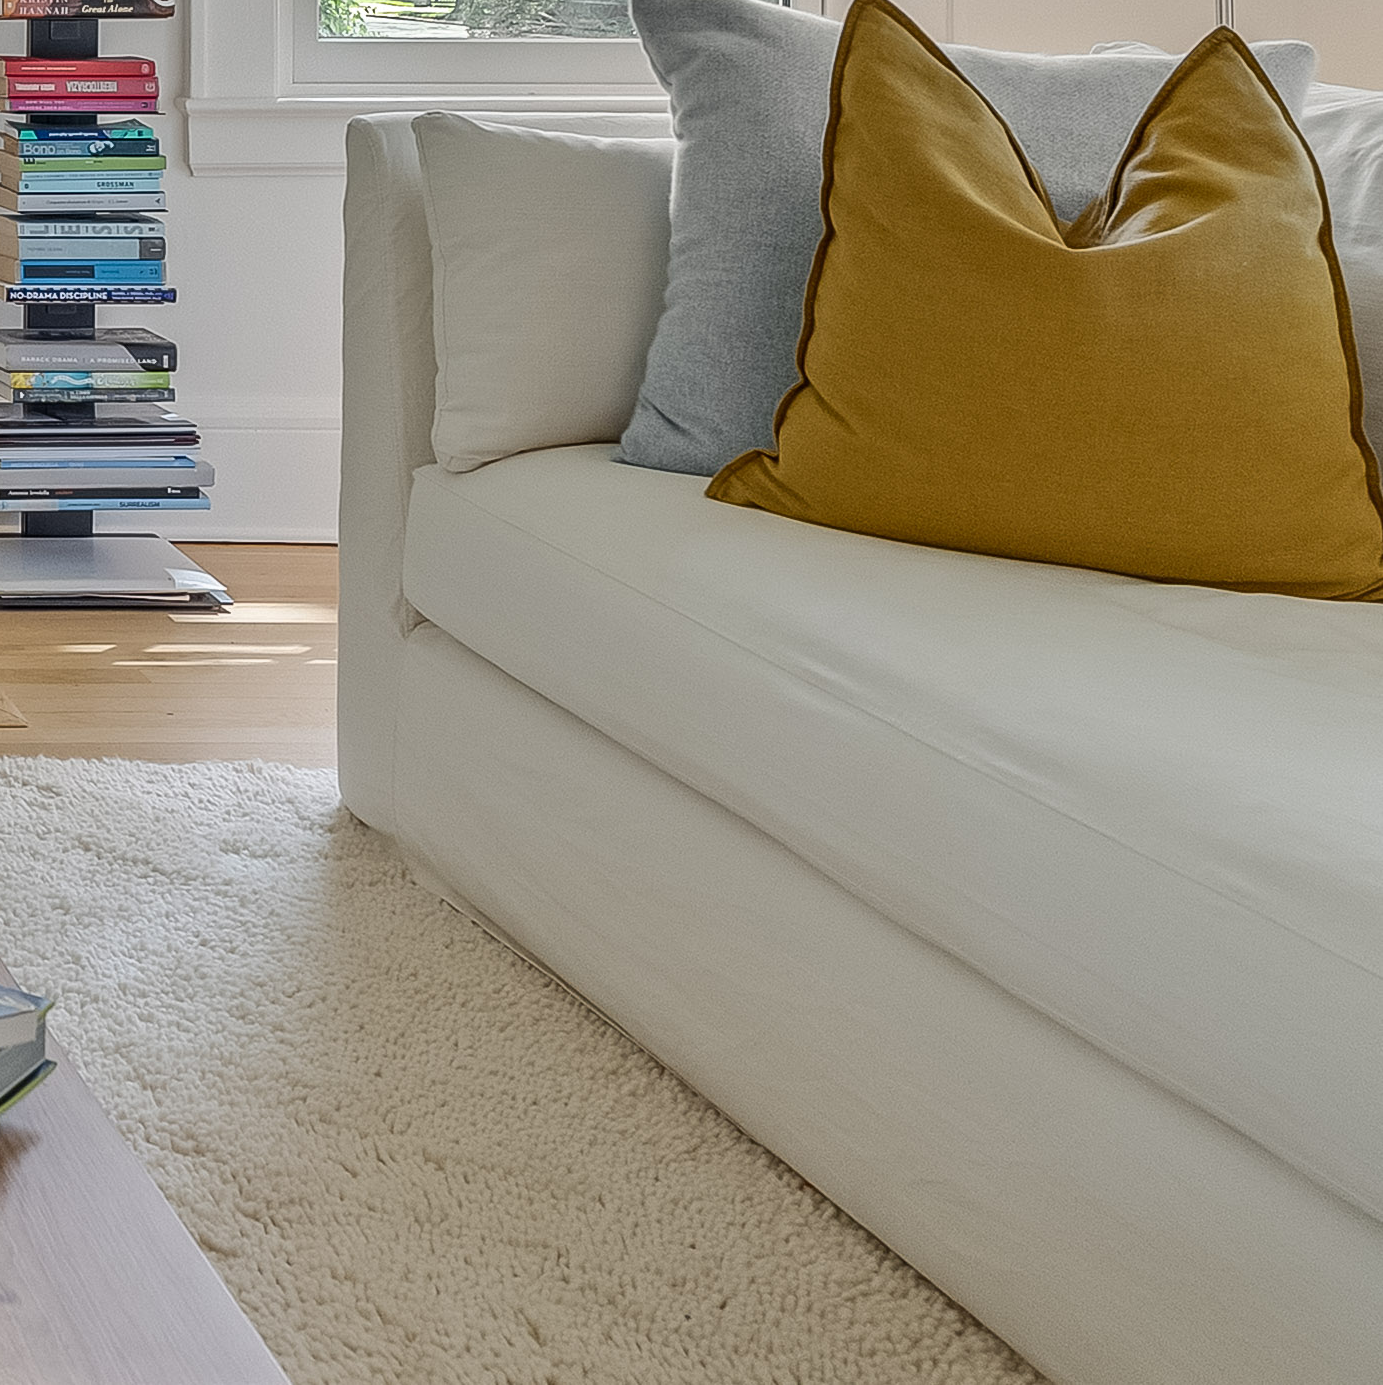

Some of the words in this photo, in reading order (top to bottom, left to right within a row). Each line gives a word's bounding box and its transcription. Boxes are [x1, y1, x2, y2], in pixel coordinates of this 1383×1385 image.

[19, 7, 69, 15] HANNAH
[81, 4, 107, 13] Great
[108, 4, 134, 13] Alone
[23, 144, 56, 155] Bono
[9, 292, 59, 300] NO-DRAMA
[59, 292, 108, 300] DISCIPLINE
